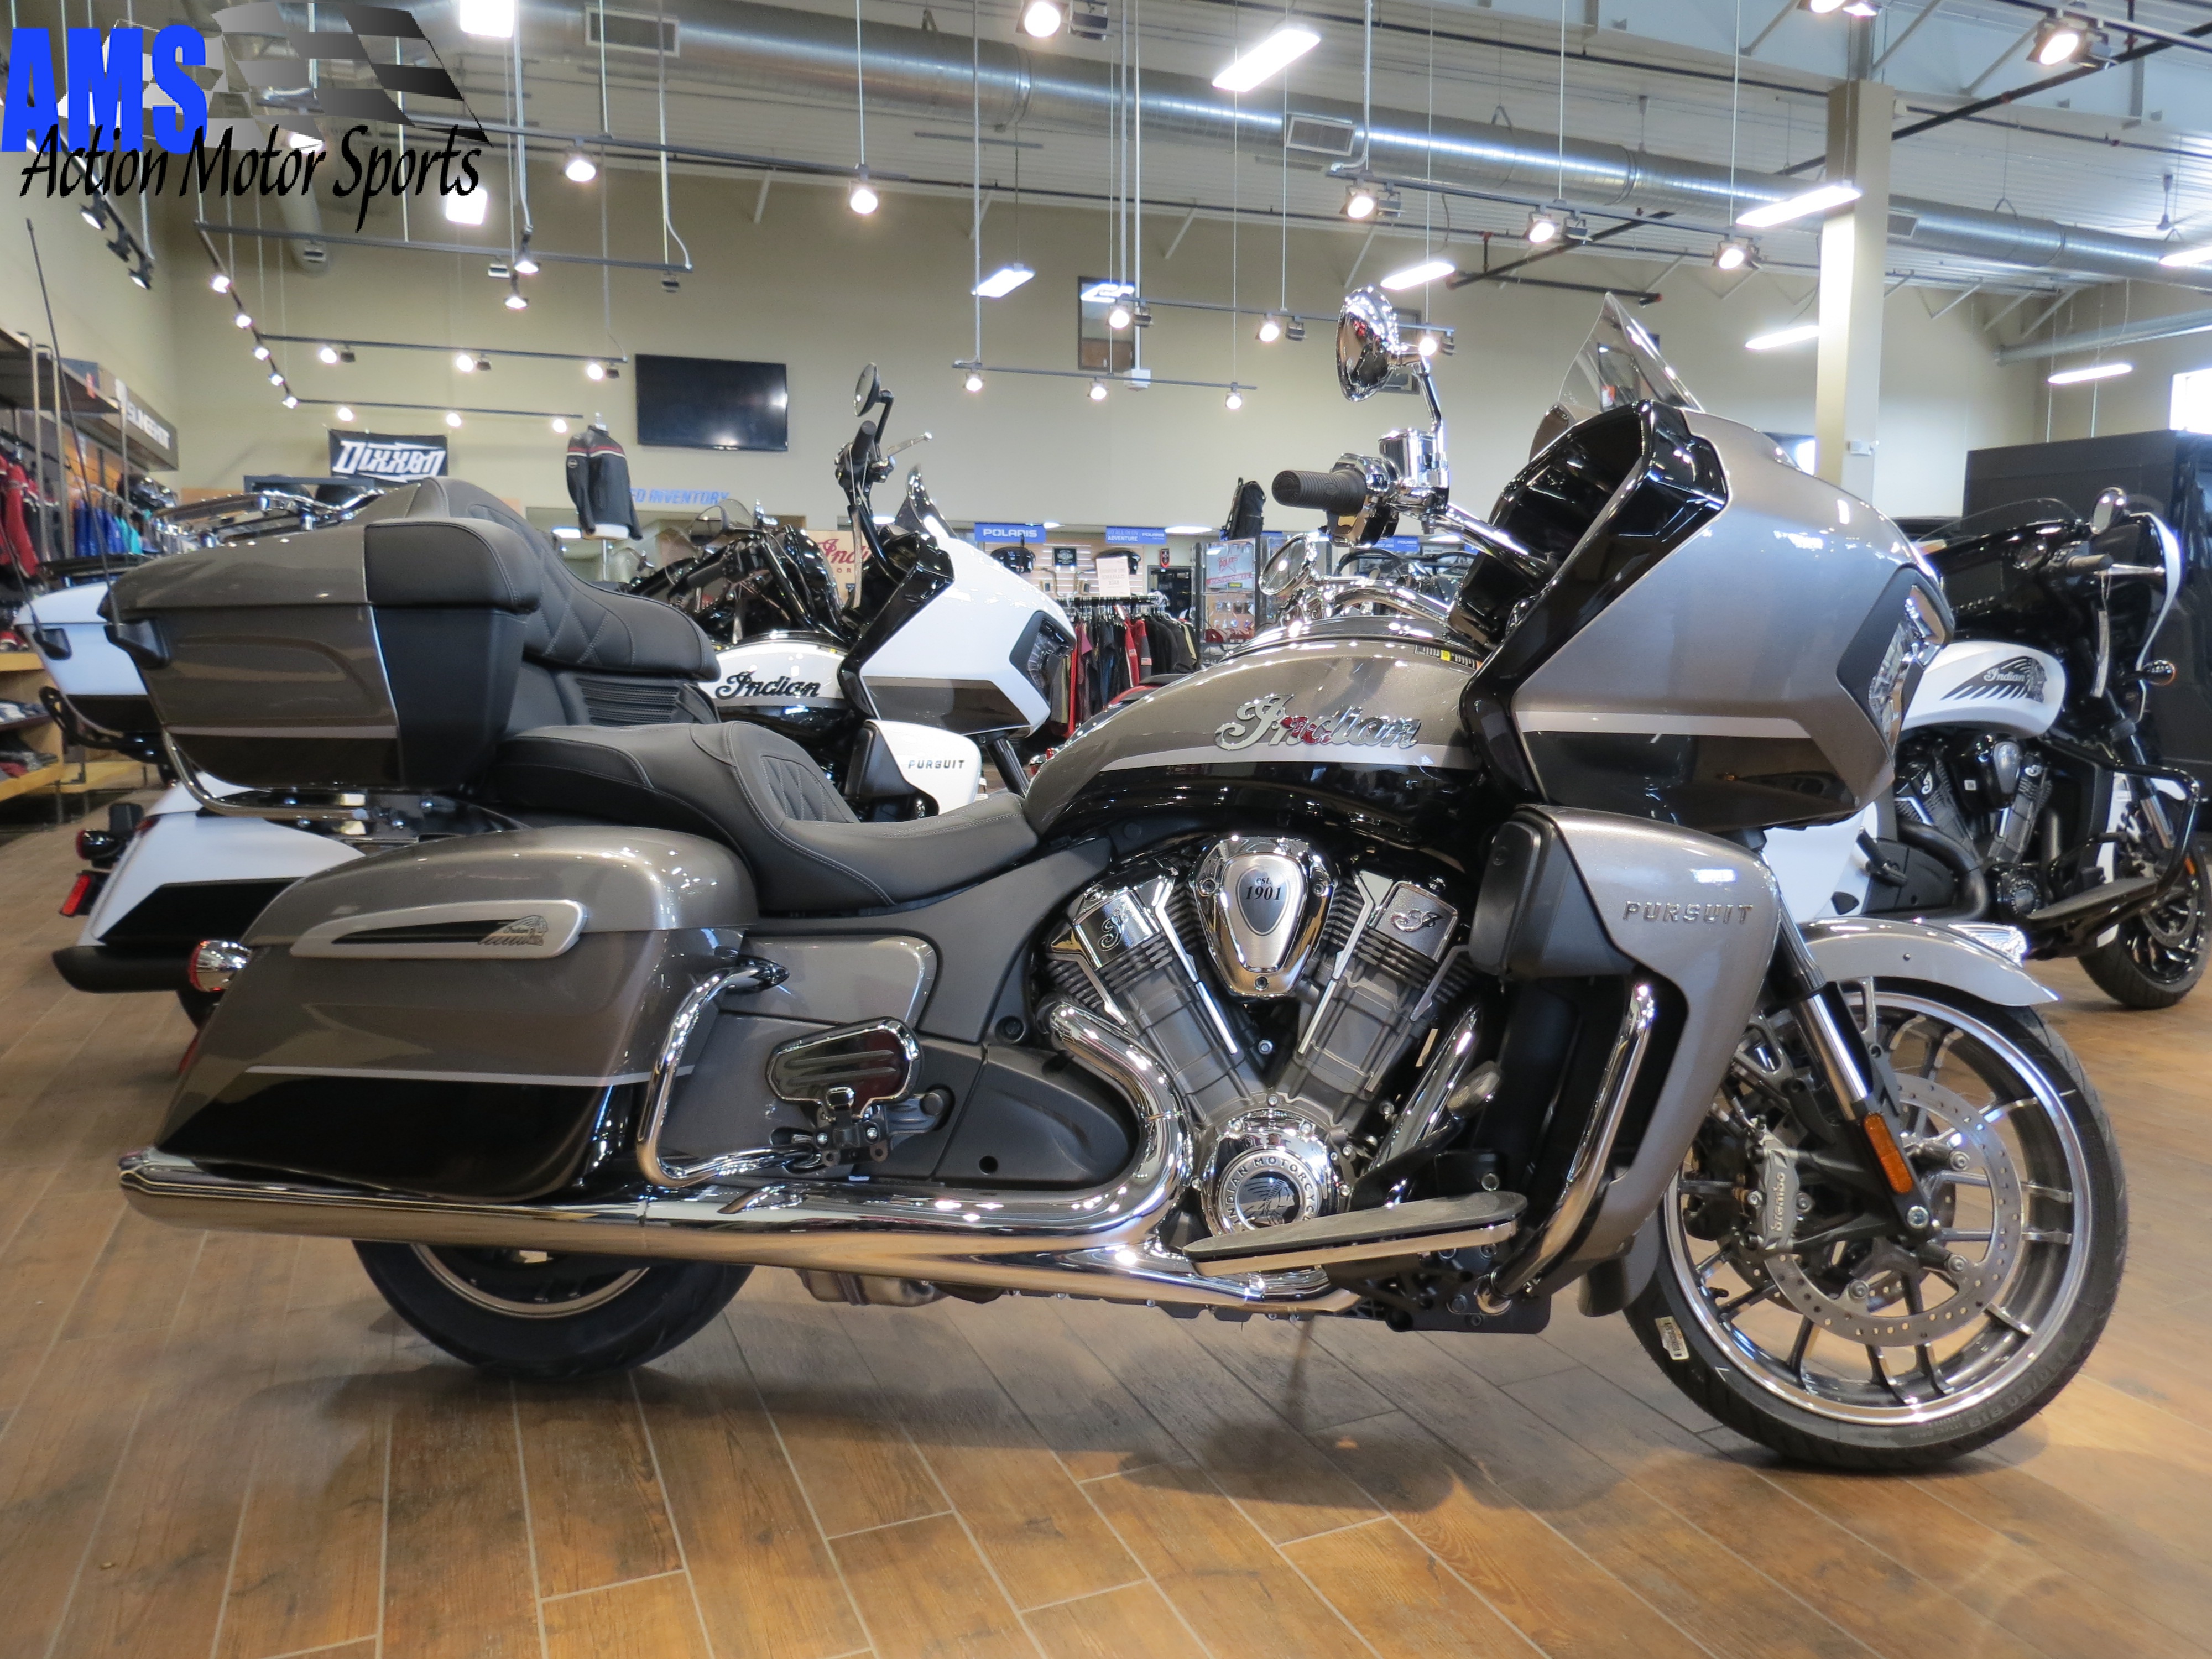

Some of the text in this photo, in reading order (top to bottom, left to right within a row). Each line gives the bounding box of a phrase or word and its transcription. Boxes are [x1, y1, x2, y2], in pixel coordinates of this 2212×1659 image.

[649, 489, 729, 505] INVENTORY
[983, 528, 1037, 538] POLARIS
[715, 670, 821, 700] Indian
[1984, 668, 2026, 682] Indian
[1214, 693, 1422, 750] Indian
[908, 760, 964, 769] PURSUIT
[1246, 886, 1281, 900] 1901
[1623, 900, 1754, 924] PURSUIT
[1253, 1156, 1316, 1222] MOTORCYCL
[1770, 1172, 1785, 1232] brembo
